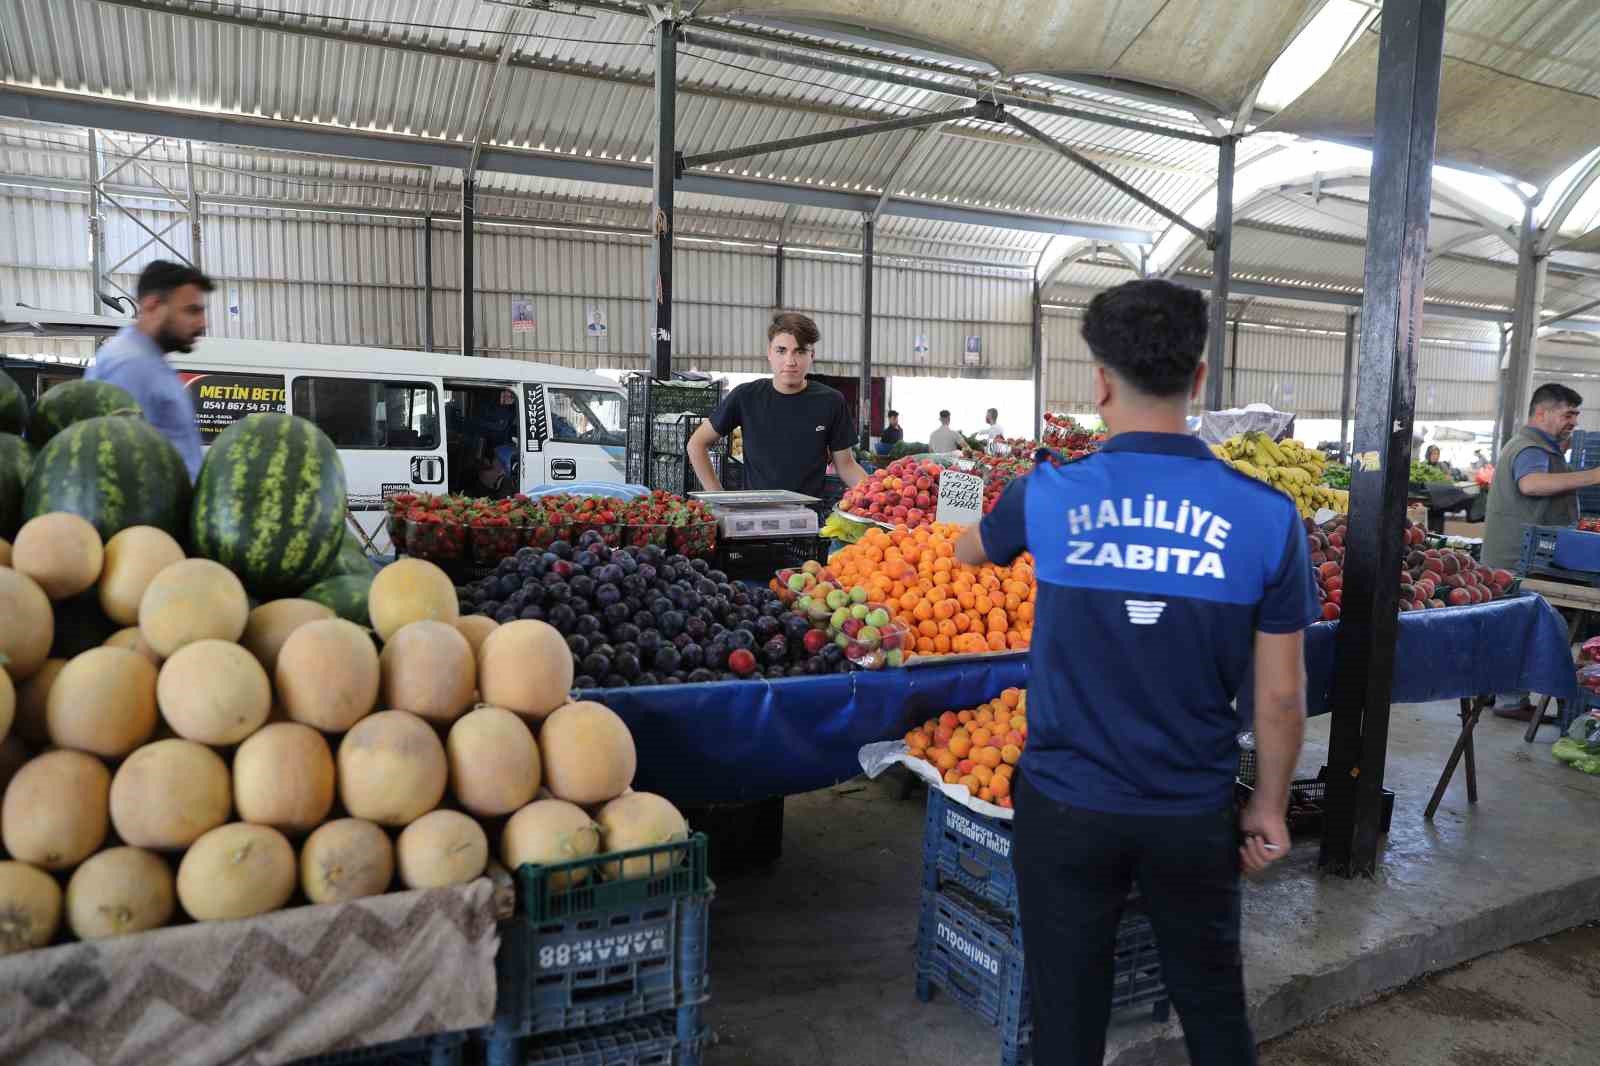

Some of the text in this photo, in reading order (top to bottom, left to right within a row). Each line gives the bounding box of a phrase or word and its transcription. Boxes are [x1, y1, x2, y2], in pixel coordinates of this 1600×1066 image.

[200, 384, 249, 400] METİN
[528, 390, 537, 439] HYUNDAI
[1067, 493, 1232, 550] HALİLİYE
[1065, 540, 1226, 579] ZABITA
[539, 943, 571, 968] 88
